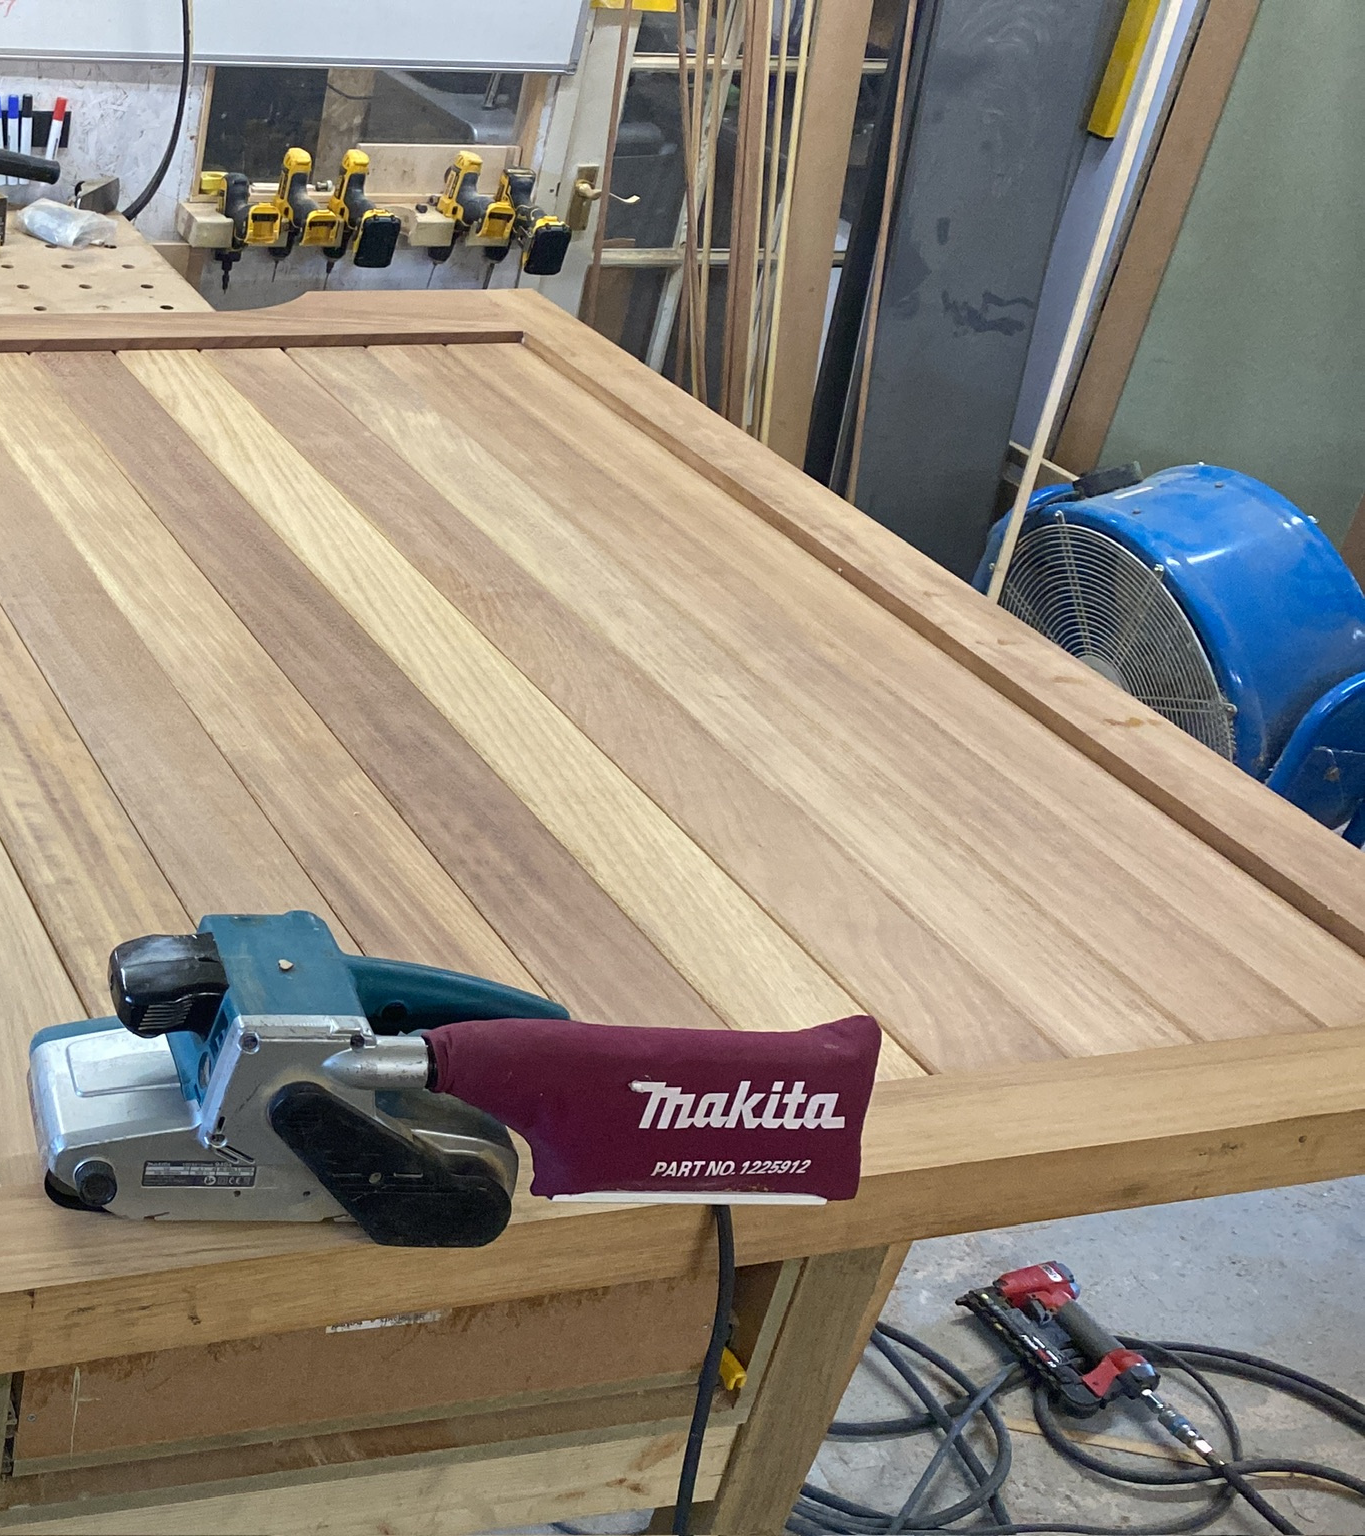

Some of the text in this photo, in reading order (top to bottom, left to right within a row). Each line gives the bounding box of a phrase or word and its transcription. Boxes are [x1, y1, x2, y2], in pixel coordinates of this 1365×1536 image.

[651, 1159, 812, 1178] PART NO. 1225912
